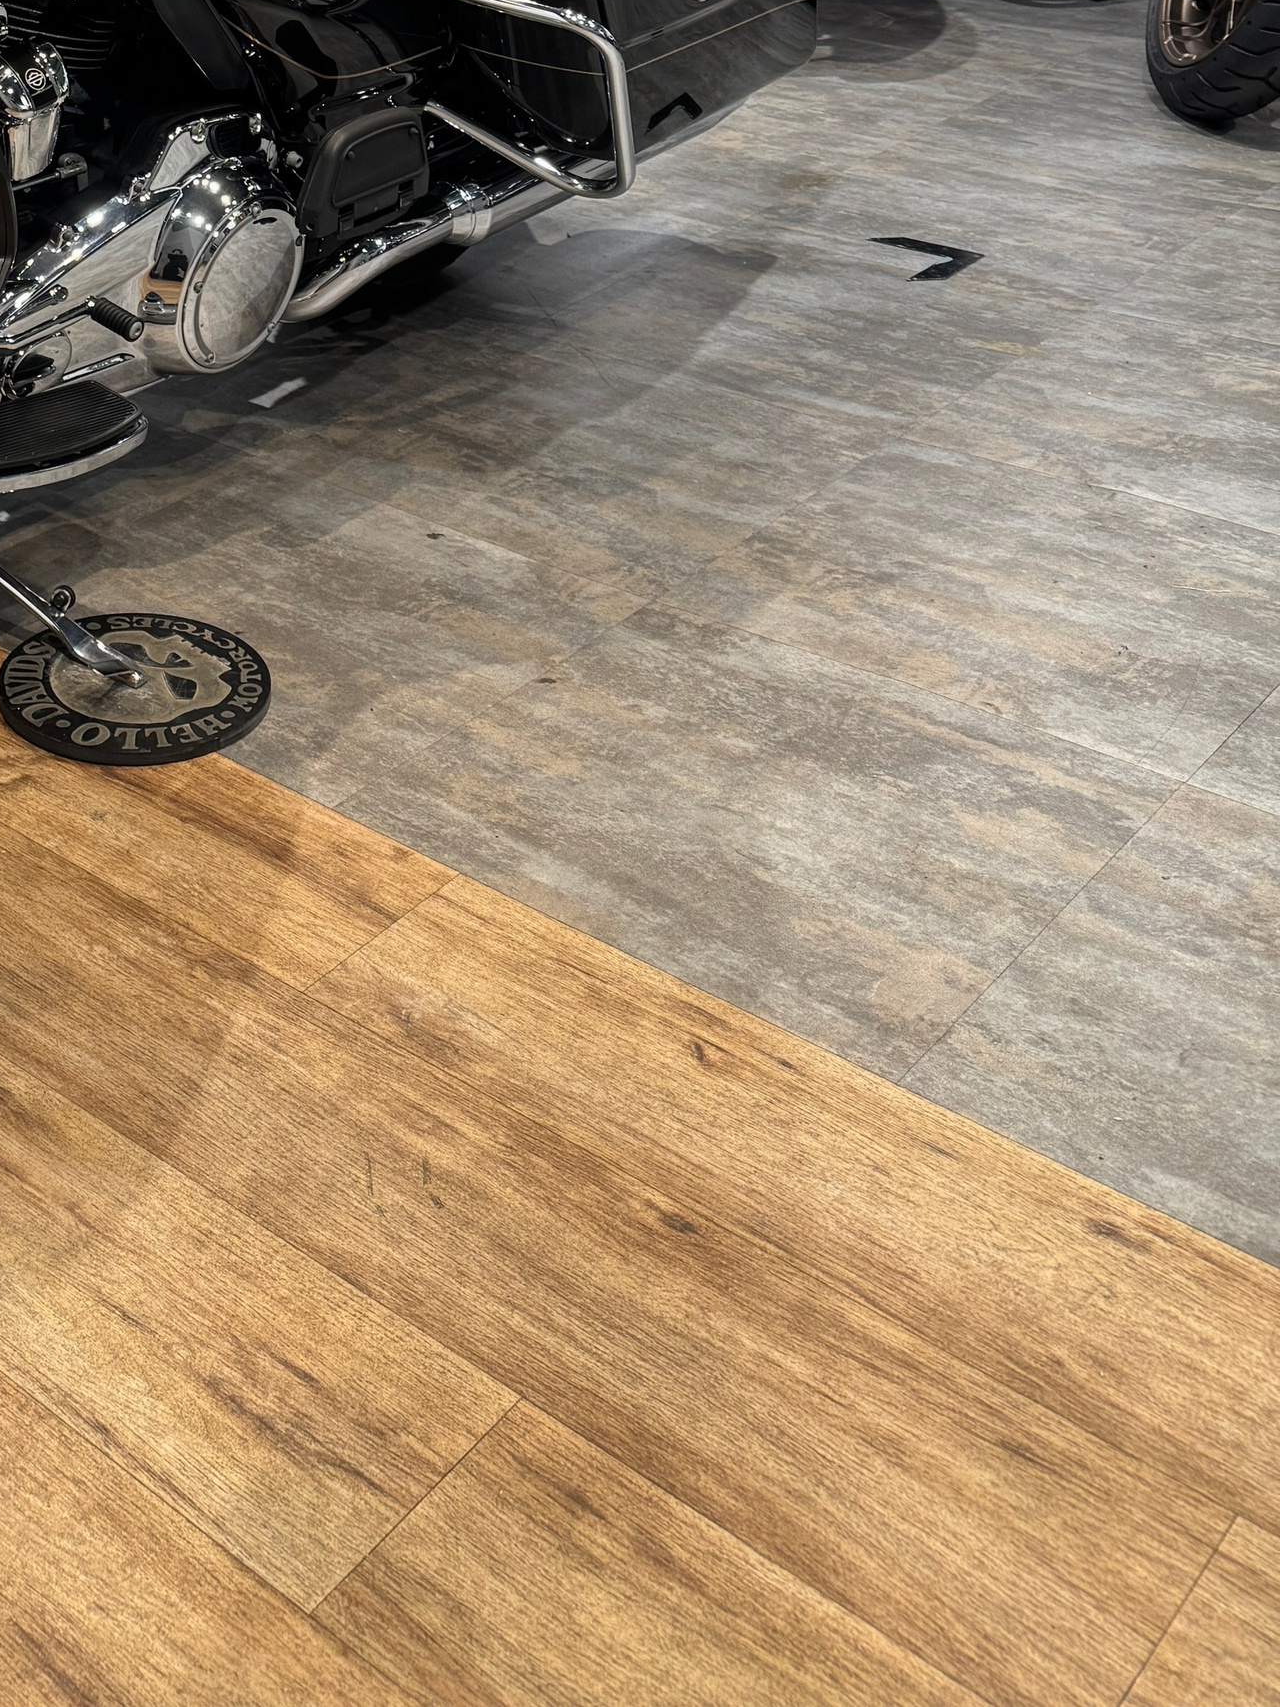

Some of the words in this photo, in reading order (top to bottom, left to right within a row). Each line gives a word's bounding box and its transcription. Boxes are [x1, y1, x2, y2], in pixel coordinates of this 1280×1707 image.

[4, 640, 70, 728] DAVIDS
[106, 616, 264, 713] MOTORCYCLES
[70, 711, 232, 751] HELLO
